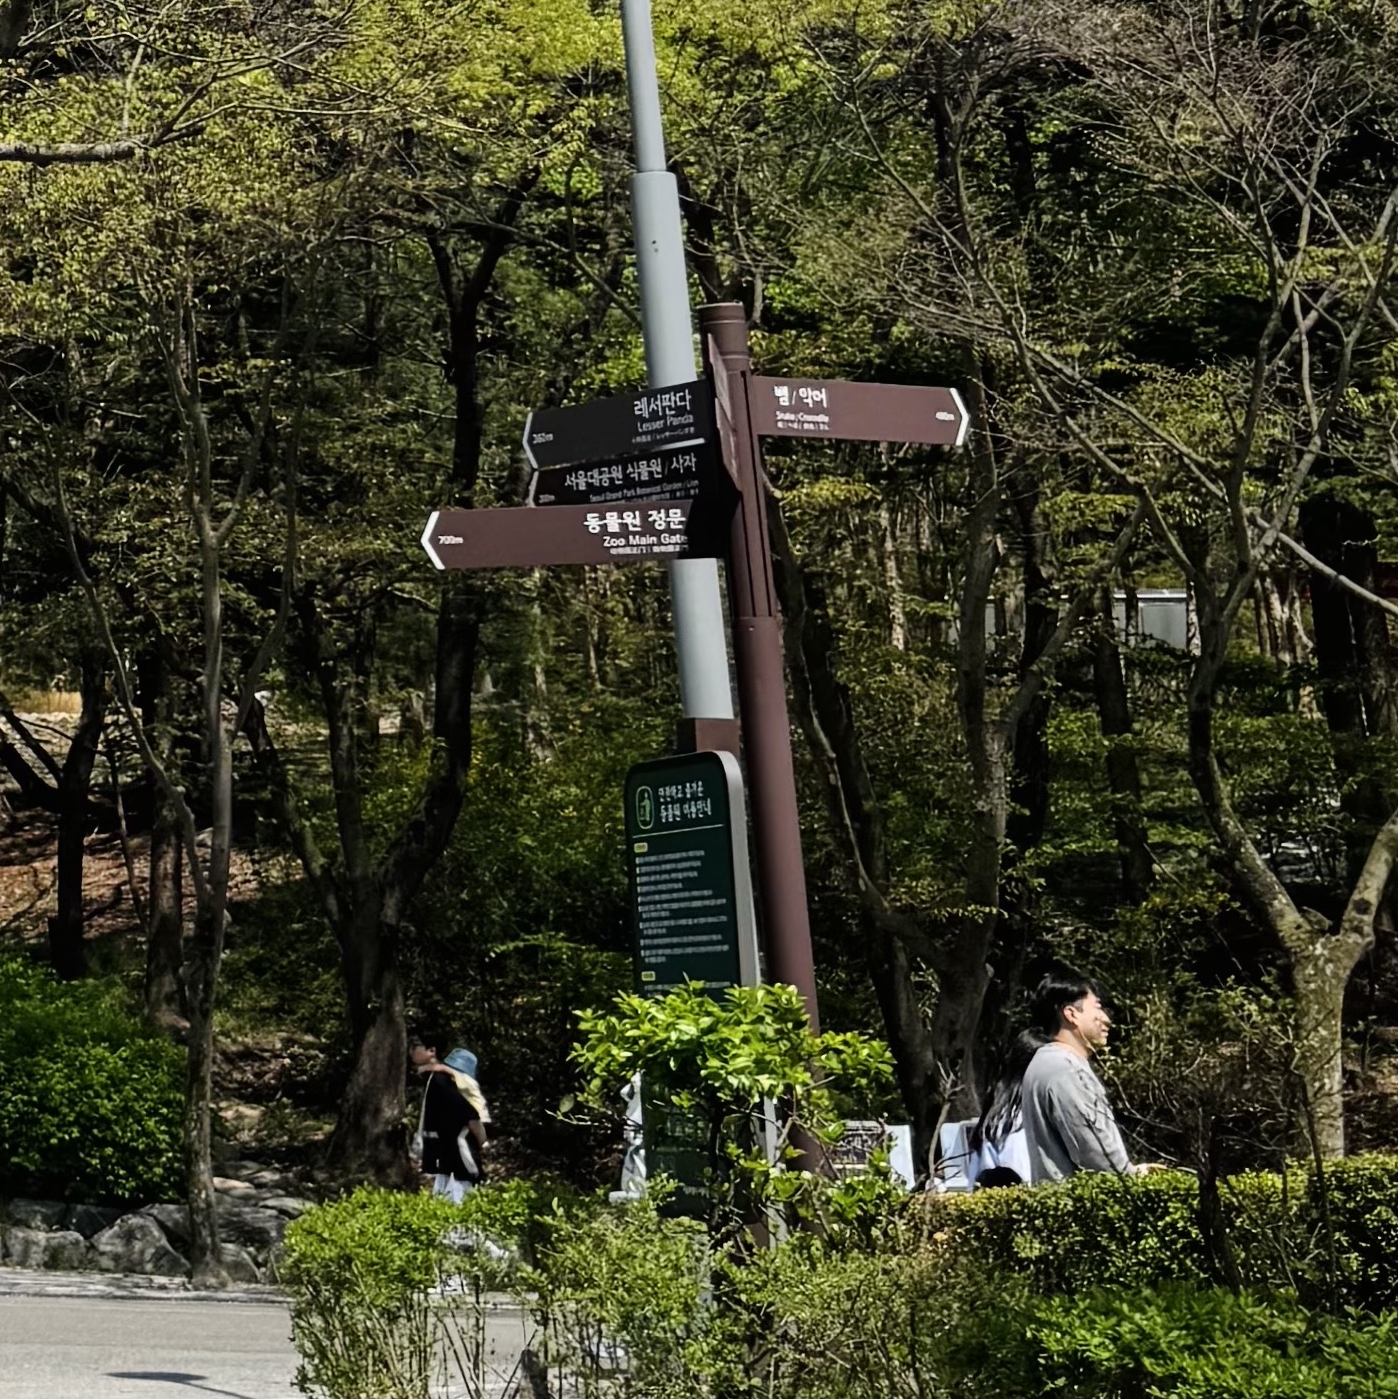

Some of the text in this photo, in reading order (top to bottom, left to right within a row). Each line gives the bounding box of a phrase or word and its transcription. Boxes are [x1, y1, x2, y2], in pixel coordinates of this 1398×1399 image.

[634, 388, 692, 419] 레서판다
[774, 385, 790, 406] 뱀
[798, 387, 827, 408] 악어
[637, 412, 694, 432] Lesser Panda
[564, 463, 624, 491] 서울대공원
[626, 457, 663, 482] 식물원
[670, 452, 698, 475] 사자
[583, 508, 687, 534] 동물원 정문
[603, 533, 688, 547] Zoo Main Gate
